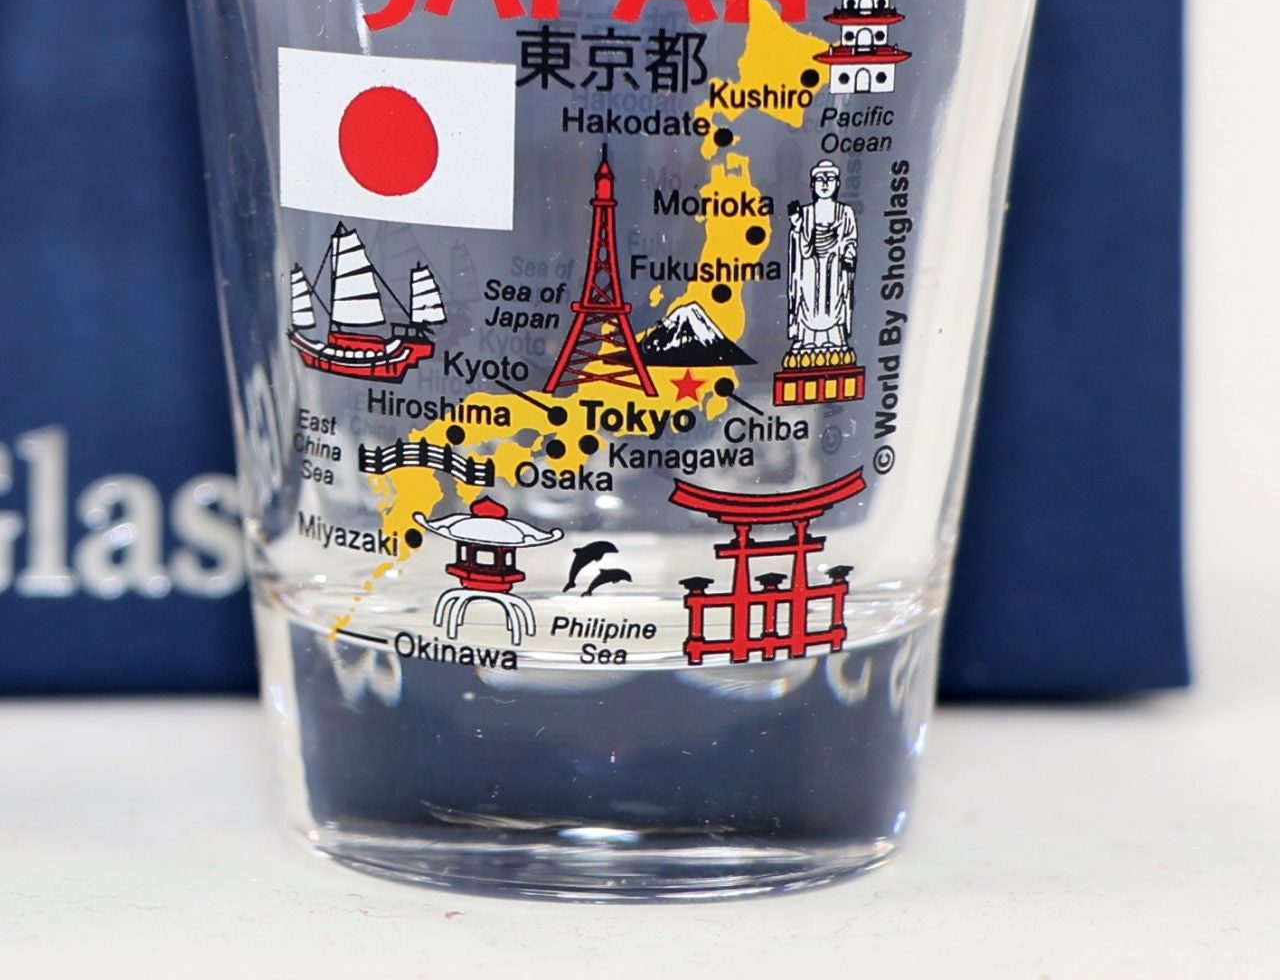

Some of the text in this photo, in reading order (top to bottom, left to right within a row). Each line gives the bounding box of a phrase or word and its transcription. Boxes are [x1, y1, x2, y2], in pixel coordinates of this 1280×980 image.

[515, 25, 709, 93] 東京都
[709, 84, 813, 109] Kushiro
[562, 108, 711, 136] Hakodate
[821, 106, 894, 128] Pacific
[821, 132, 893, 153] Ocean
[653, 189, 775, 216] Morioka
[880, 158, 913, 300] Shotglass
[631, 255, 782, 282] Fukushima
[484, 280, 567, 304] Sea of
[484, 307, 561, 332] Japan
[879, 309, 908, 347] By
[443, 351, 529, 384] Kyoto
[368, 388, 512, 426] Hiroshima
[874, 355, 901, 439] World
[298, 408, 337, 435] East
[579, 400, 697, 439] Tokyo
[724, 417, 810, 443] Chiba
[293, 432, 342, 461] China
[609, 443, 754, 475] Kanagawa
[300, 461, 334, 485] Sea
[515, 462, 613, 491] Osaka
[298, 512, 398, 557] Miyazaki
[550, 616, 657, 642] Philipine
[394, 631, 519, 670] Okinawa
[580, 644, 628, 665] Sea
